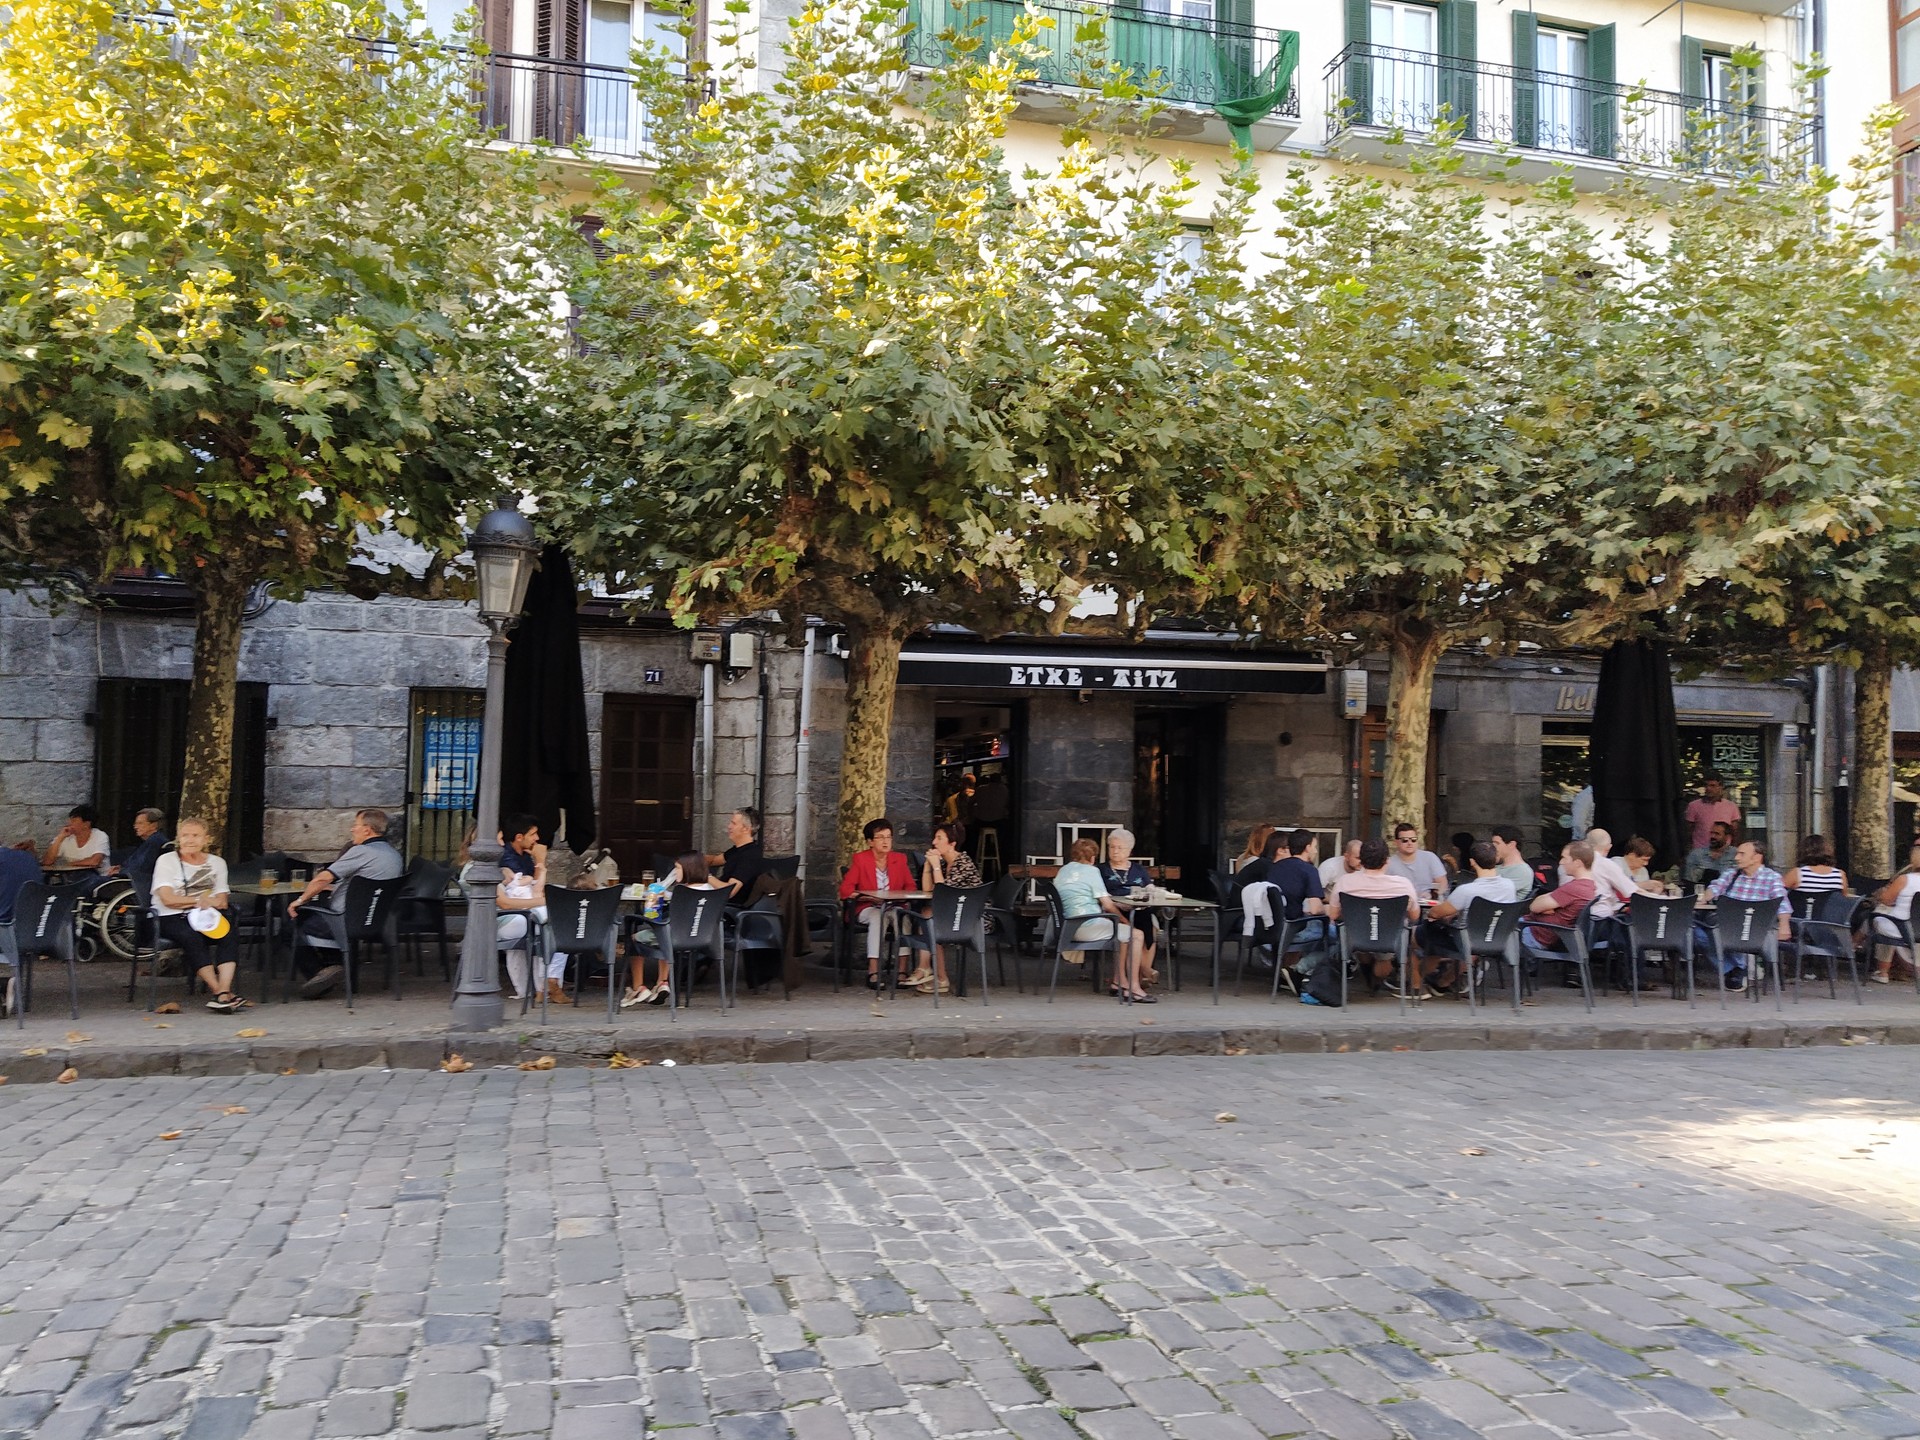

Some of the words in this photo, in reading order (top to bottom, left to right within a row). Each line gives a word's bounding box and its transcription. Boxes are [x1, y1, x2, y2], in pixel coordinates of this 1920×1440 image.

[646, 671, 660, 682] 71
[1010, 666, 1083, 686] ETXE
[1556, 686, 1595, 710] Bel
[1712, 734, 1759, 750] BASQUE
[1712, 747, 1760, 761] LABEL
[35, 904, 52, 937] Heineken
[576, 908, 587, 938] Heineken
[690, 906, 703, 936] Heineken
[952, 903, 964, 931] Heineken
[1370, 914, 1378, 940] Heineken
[1484, 917, 1499, 942] Heineken
[1656, 913, 1666, 939] Heineken
[1740, 915, 1752, 941] Heineken
